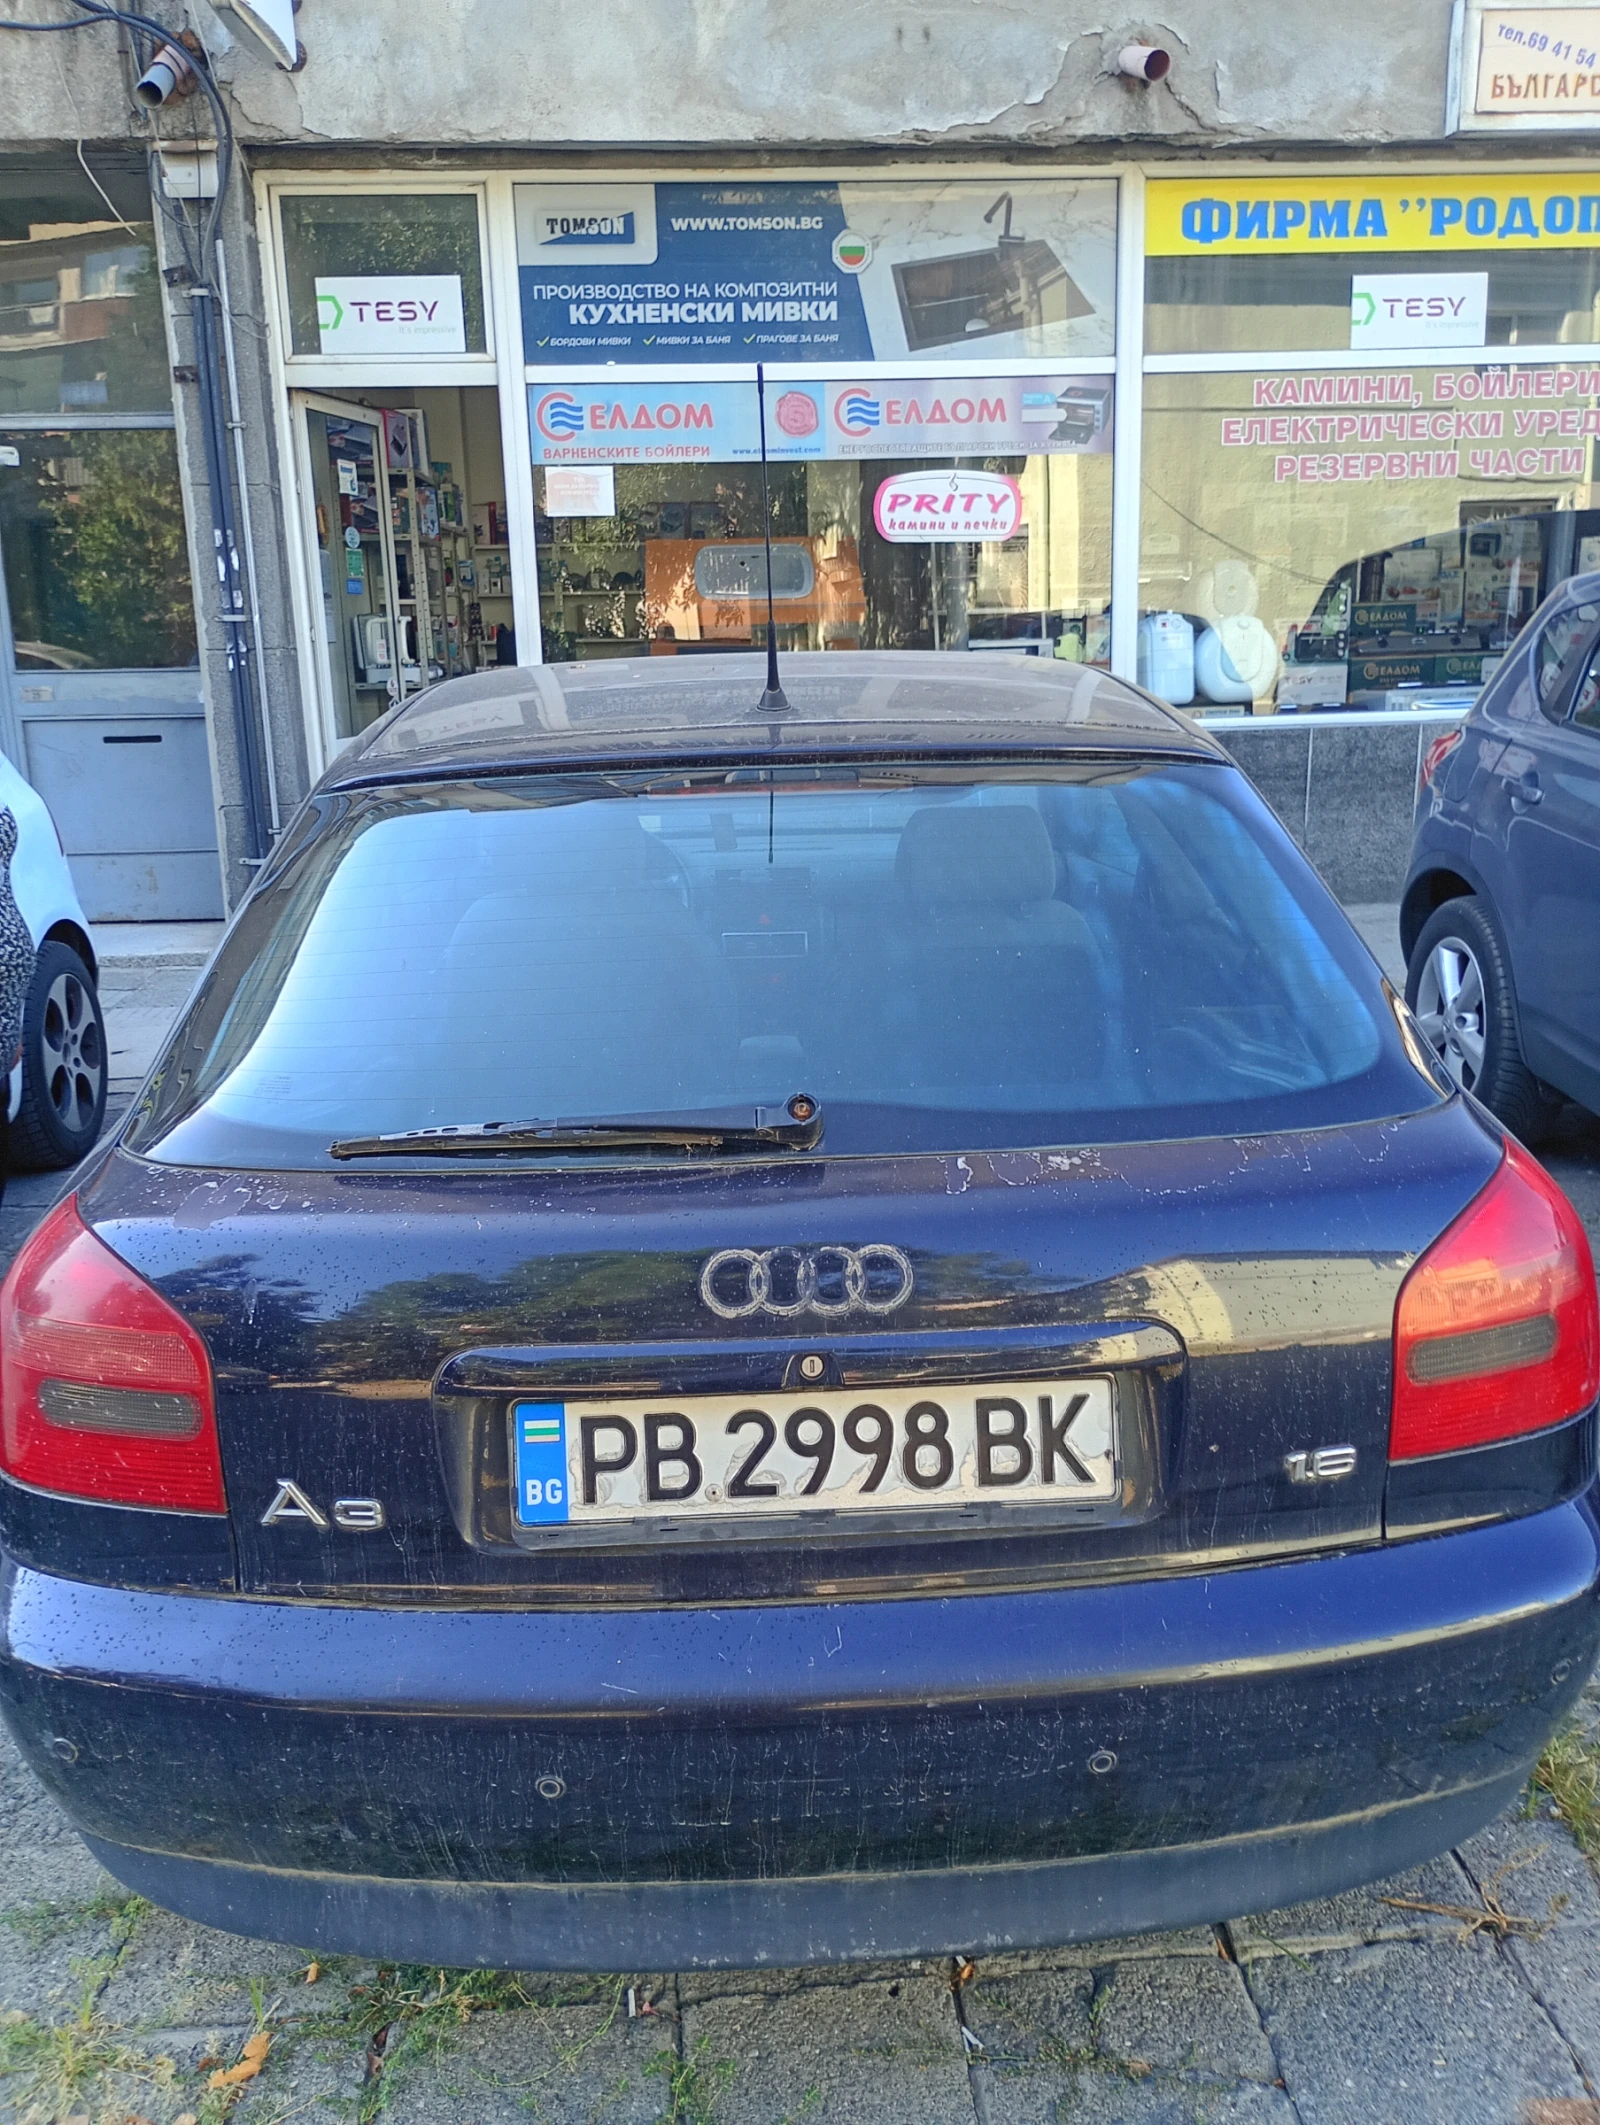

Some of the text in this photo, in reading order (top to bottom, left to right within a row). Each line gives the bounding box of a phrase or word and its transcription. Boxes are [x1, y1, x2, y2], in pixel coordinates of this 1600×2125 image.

[1551, 40, 1573, 60] 41
[1575, 48, 1597, 69] 54
[546, 216, 625, 235] TOMSON
[671, 216, 823, 231] WWW.TOMSON.BG
[1181, 198, 1388, 243] ФИРМА
[533, 281, 838, 302] ПРОИЗВОДСТВО НА КОМПОЗИТНИ
[349, 300, 439, 323] TESY
[568, 300, 838, 325] КУХНЕНСКИ МИВКИ
[1382, 296, 1467, 319] TESY
[550, 336, 631, 347] БОРДОВИ МИВКИ
[656, 334, 731, 345] МИВКИ ЗА БАНЯ
[756, 333, 839, 344] ПРАГОВЕ ЗА БАНЯ
[1253, 365, 1600, 408] КАМИНИ, БОЙЛЕРИ
[590, 403, 714, 430] ЕЛДОМ
[886, 398, 1008, 425] ЕЛДОМ
[1221, 408, 1600, 446] ЕЛЕКТРИЧЕСКИ УРЕД
[543, 443, 711, 459] ВАРНЕНСКИТЕ БОЙЛЕРИ
[1274, 447, 1585, 483] РЕЗЕРВНИ ЧАСТИ
[888, 517, 1008, 532] камини и печки
[1370, 611, 1408, 622] ЕЛДОМ
[1380, 664, 1421, 676] ЕЛДОМ
[579, 1393, 1097, 1506] PB 2998 BK
[526, 1479, 563, 1506] BG
[261, 1478, 385, 1531] A3
